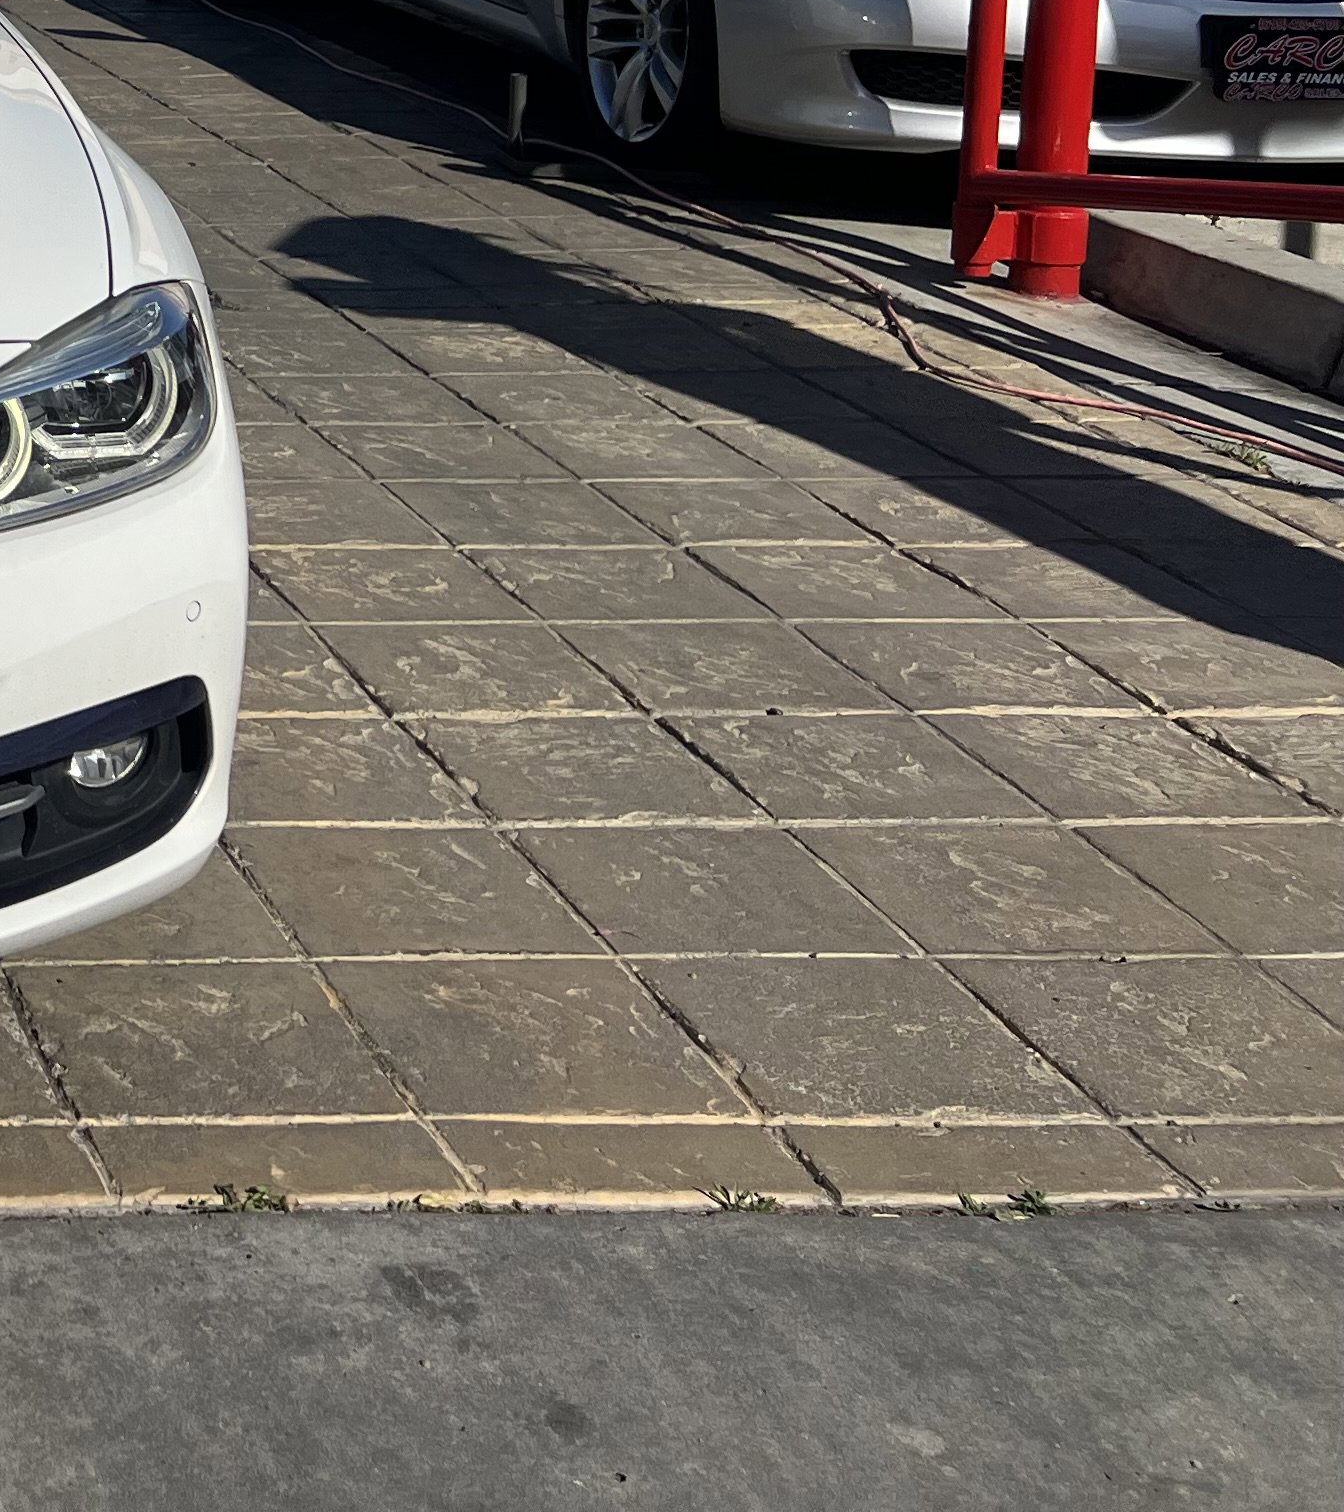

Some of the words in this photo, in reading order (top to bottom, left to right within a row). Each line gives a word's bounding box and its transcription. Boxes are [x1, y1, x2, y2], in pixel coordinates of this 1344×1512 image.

[1223, 33, 1344, 71] CARC
[1227, 71, 1278, 84] SALES
[1280, 72, 1292, 84] &
